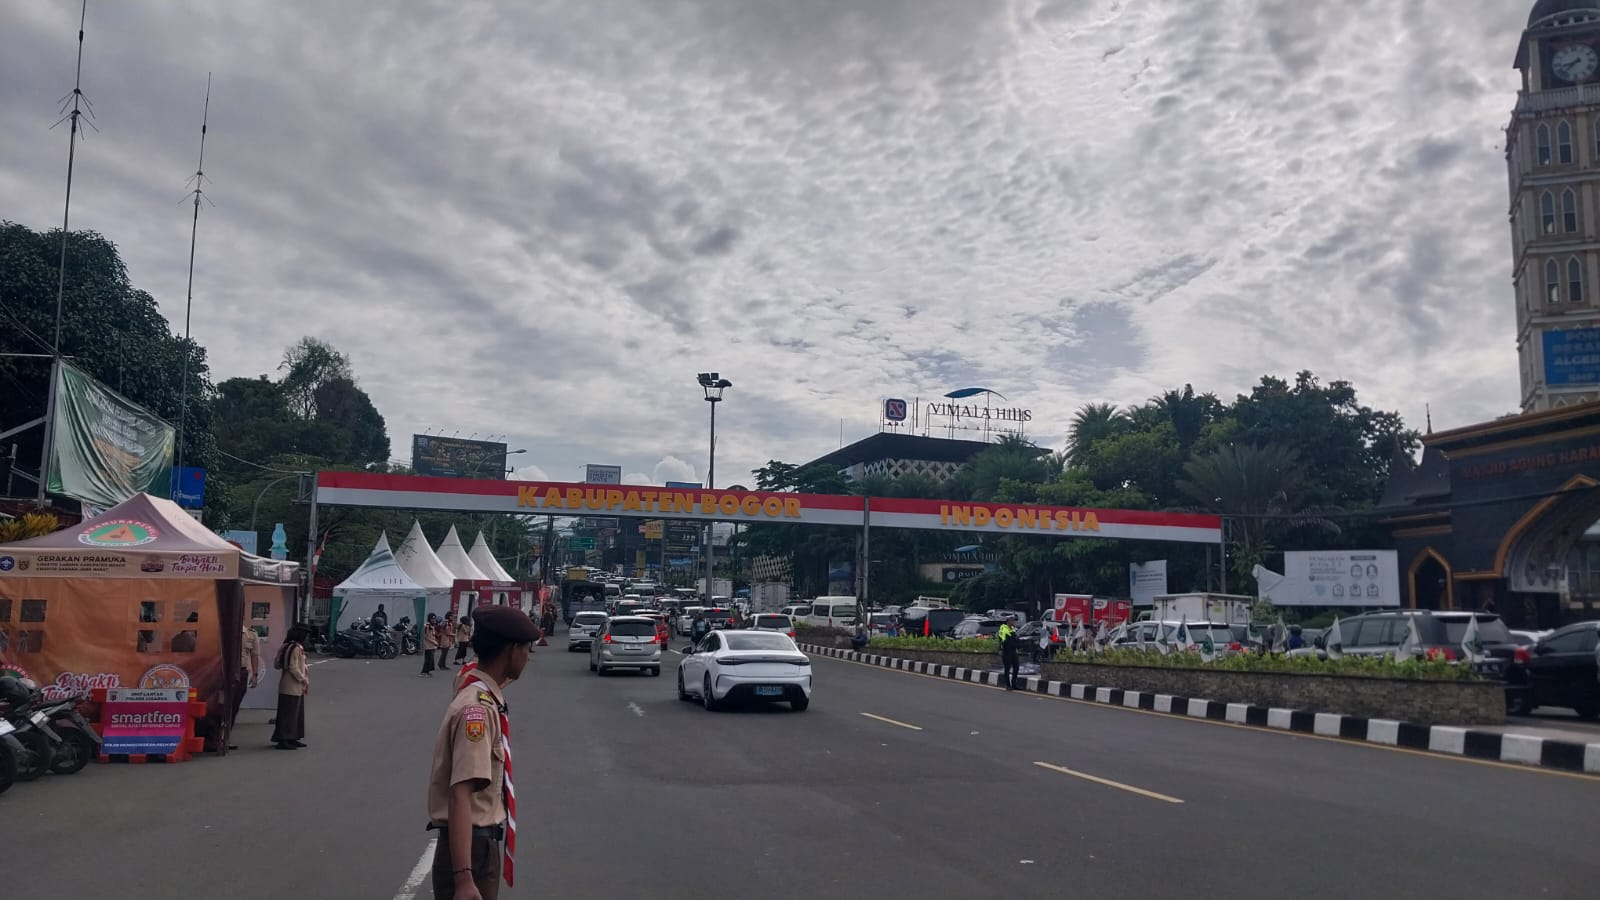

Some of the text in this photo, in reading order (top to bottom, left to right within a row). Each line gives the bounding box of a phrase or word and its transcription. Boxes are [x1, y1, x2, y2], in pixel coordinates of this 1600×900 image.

[517, 485, 801, 517] KABUPATEN BOGOR
[940, 504, 1099, 531] INDONESIA
[57, 672, 119, 690] Berbakti
[111, 711, 181, 723] smartfren
